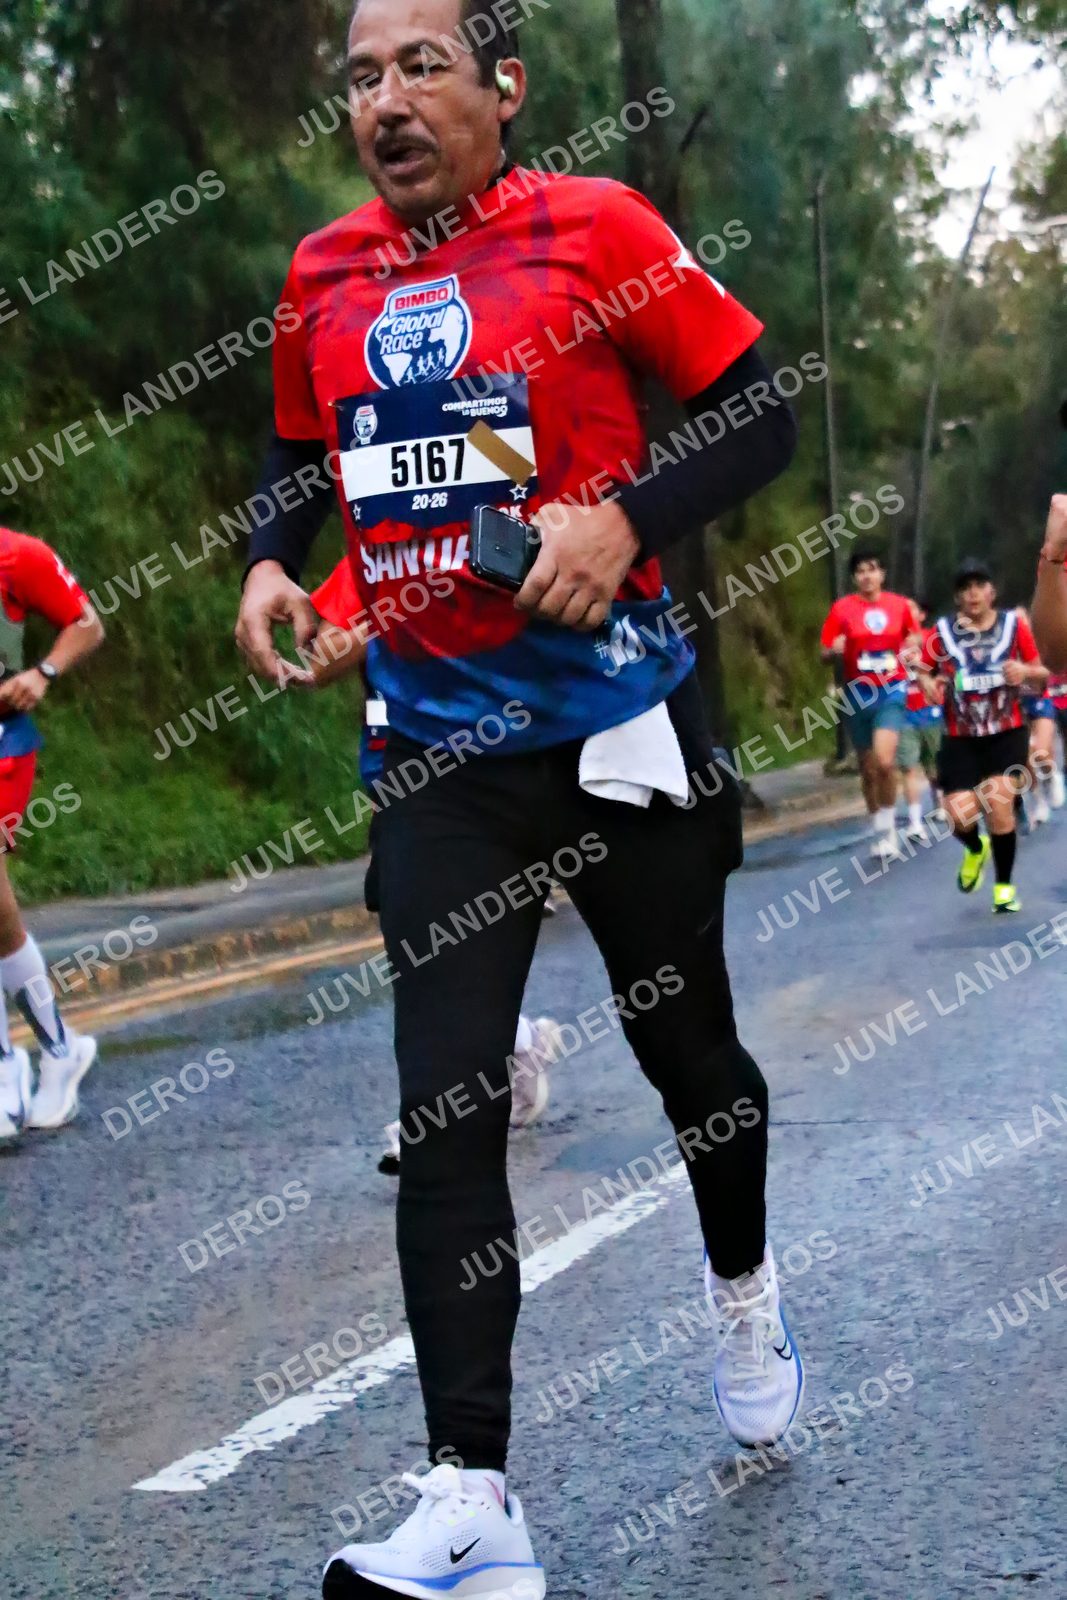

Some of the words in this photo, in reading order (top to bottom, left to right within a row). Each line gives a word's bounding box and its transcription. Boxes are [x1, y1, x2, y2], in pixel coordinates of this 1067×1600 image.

[395, 288, 448, 311] BIMBO
[391, 307, 447, 335] Global
[380, 332, 423, 354] Race
[391, 438, 464, 487] 5167
